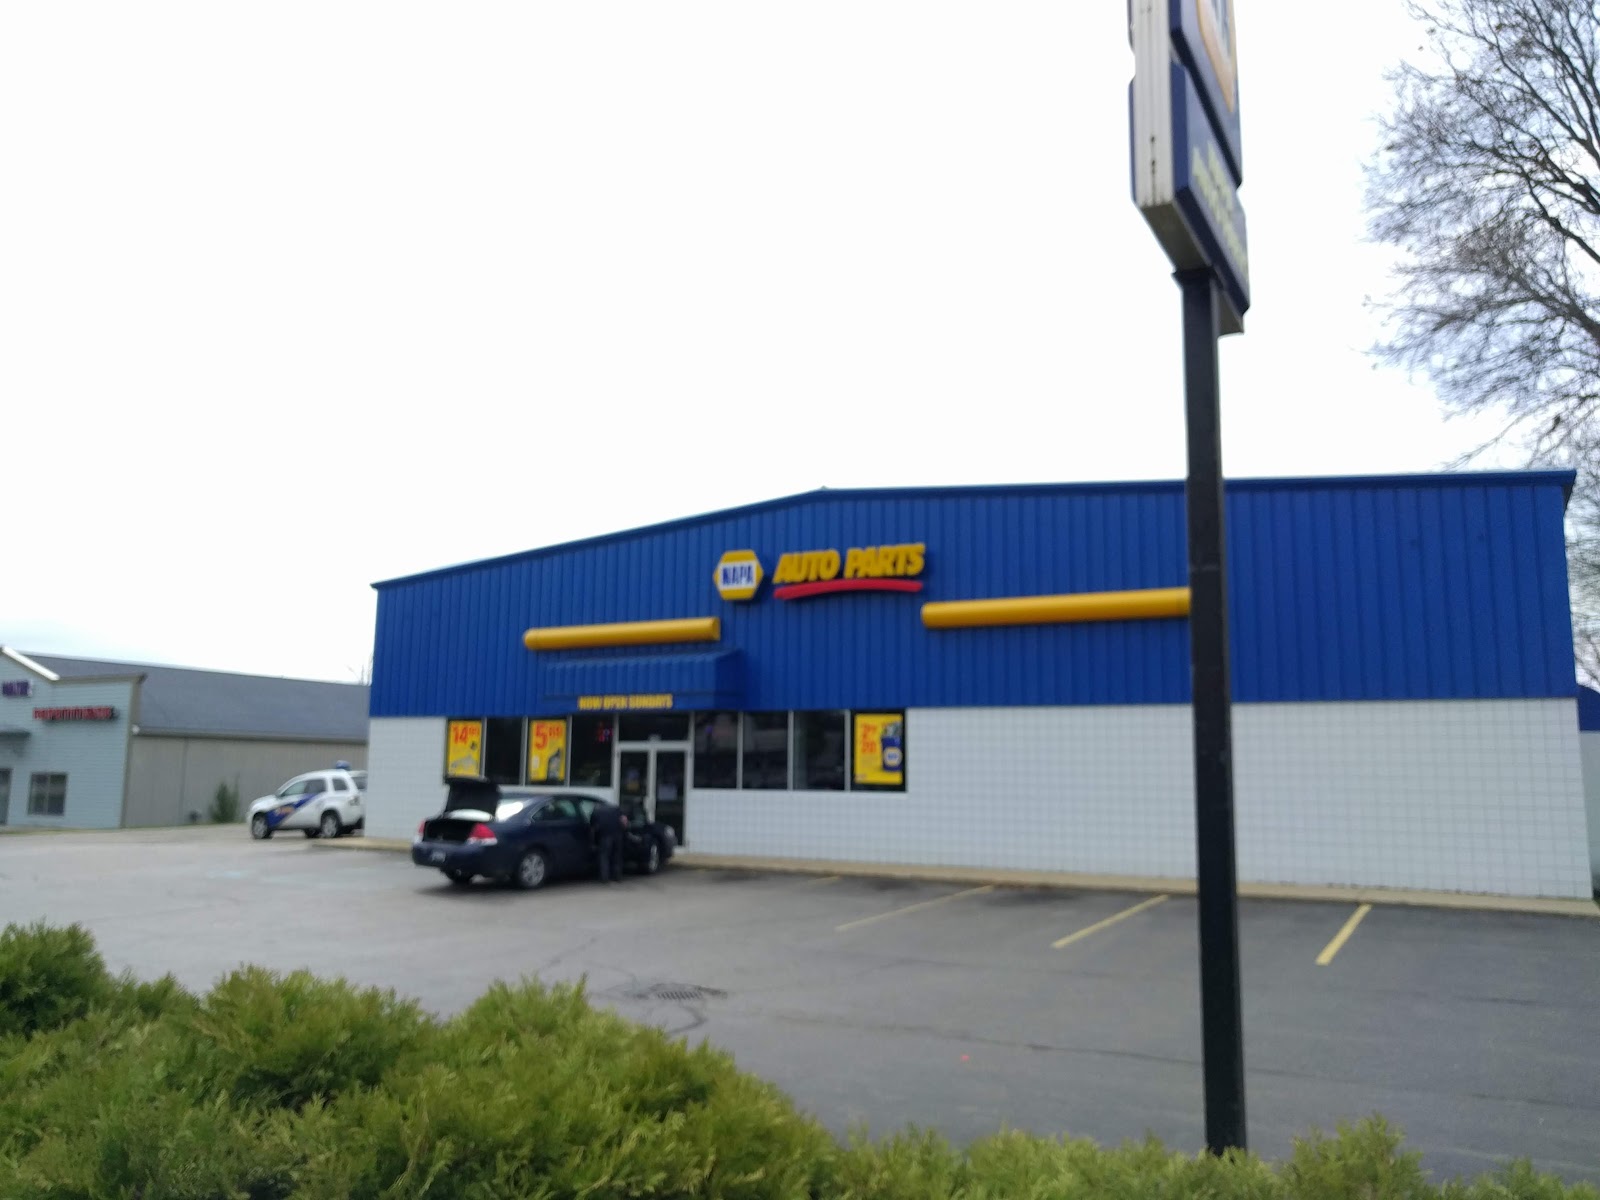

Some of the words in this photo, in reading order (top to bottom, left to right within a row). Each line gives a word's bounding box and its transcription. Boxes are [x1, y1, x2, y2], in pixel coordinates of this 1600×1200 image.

[722, 565, 753, 585] NAPA
[772, 550, 841, 584] AUTO
[844, 543, 926, 579] PARTS
